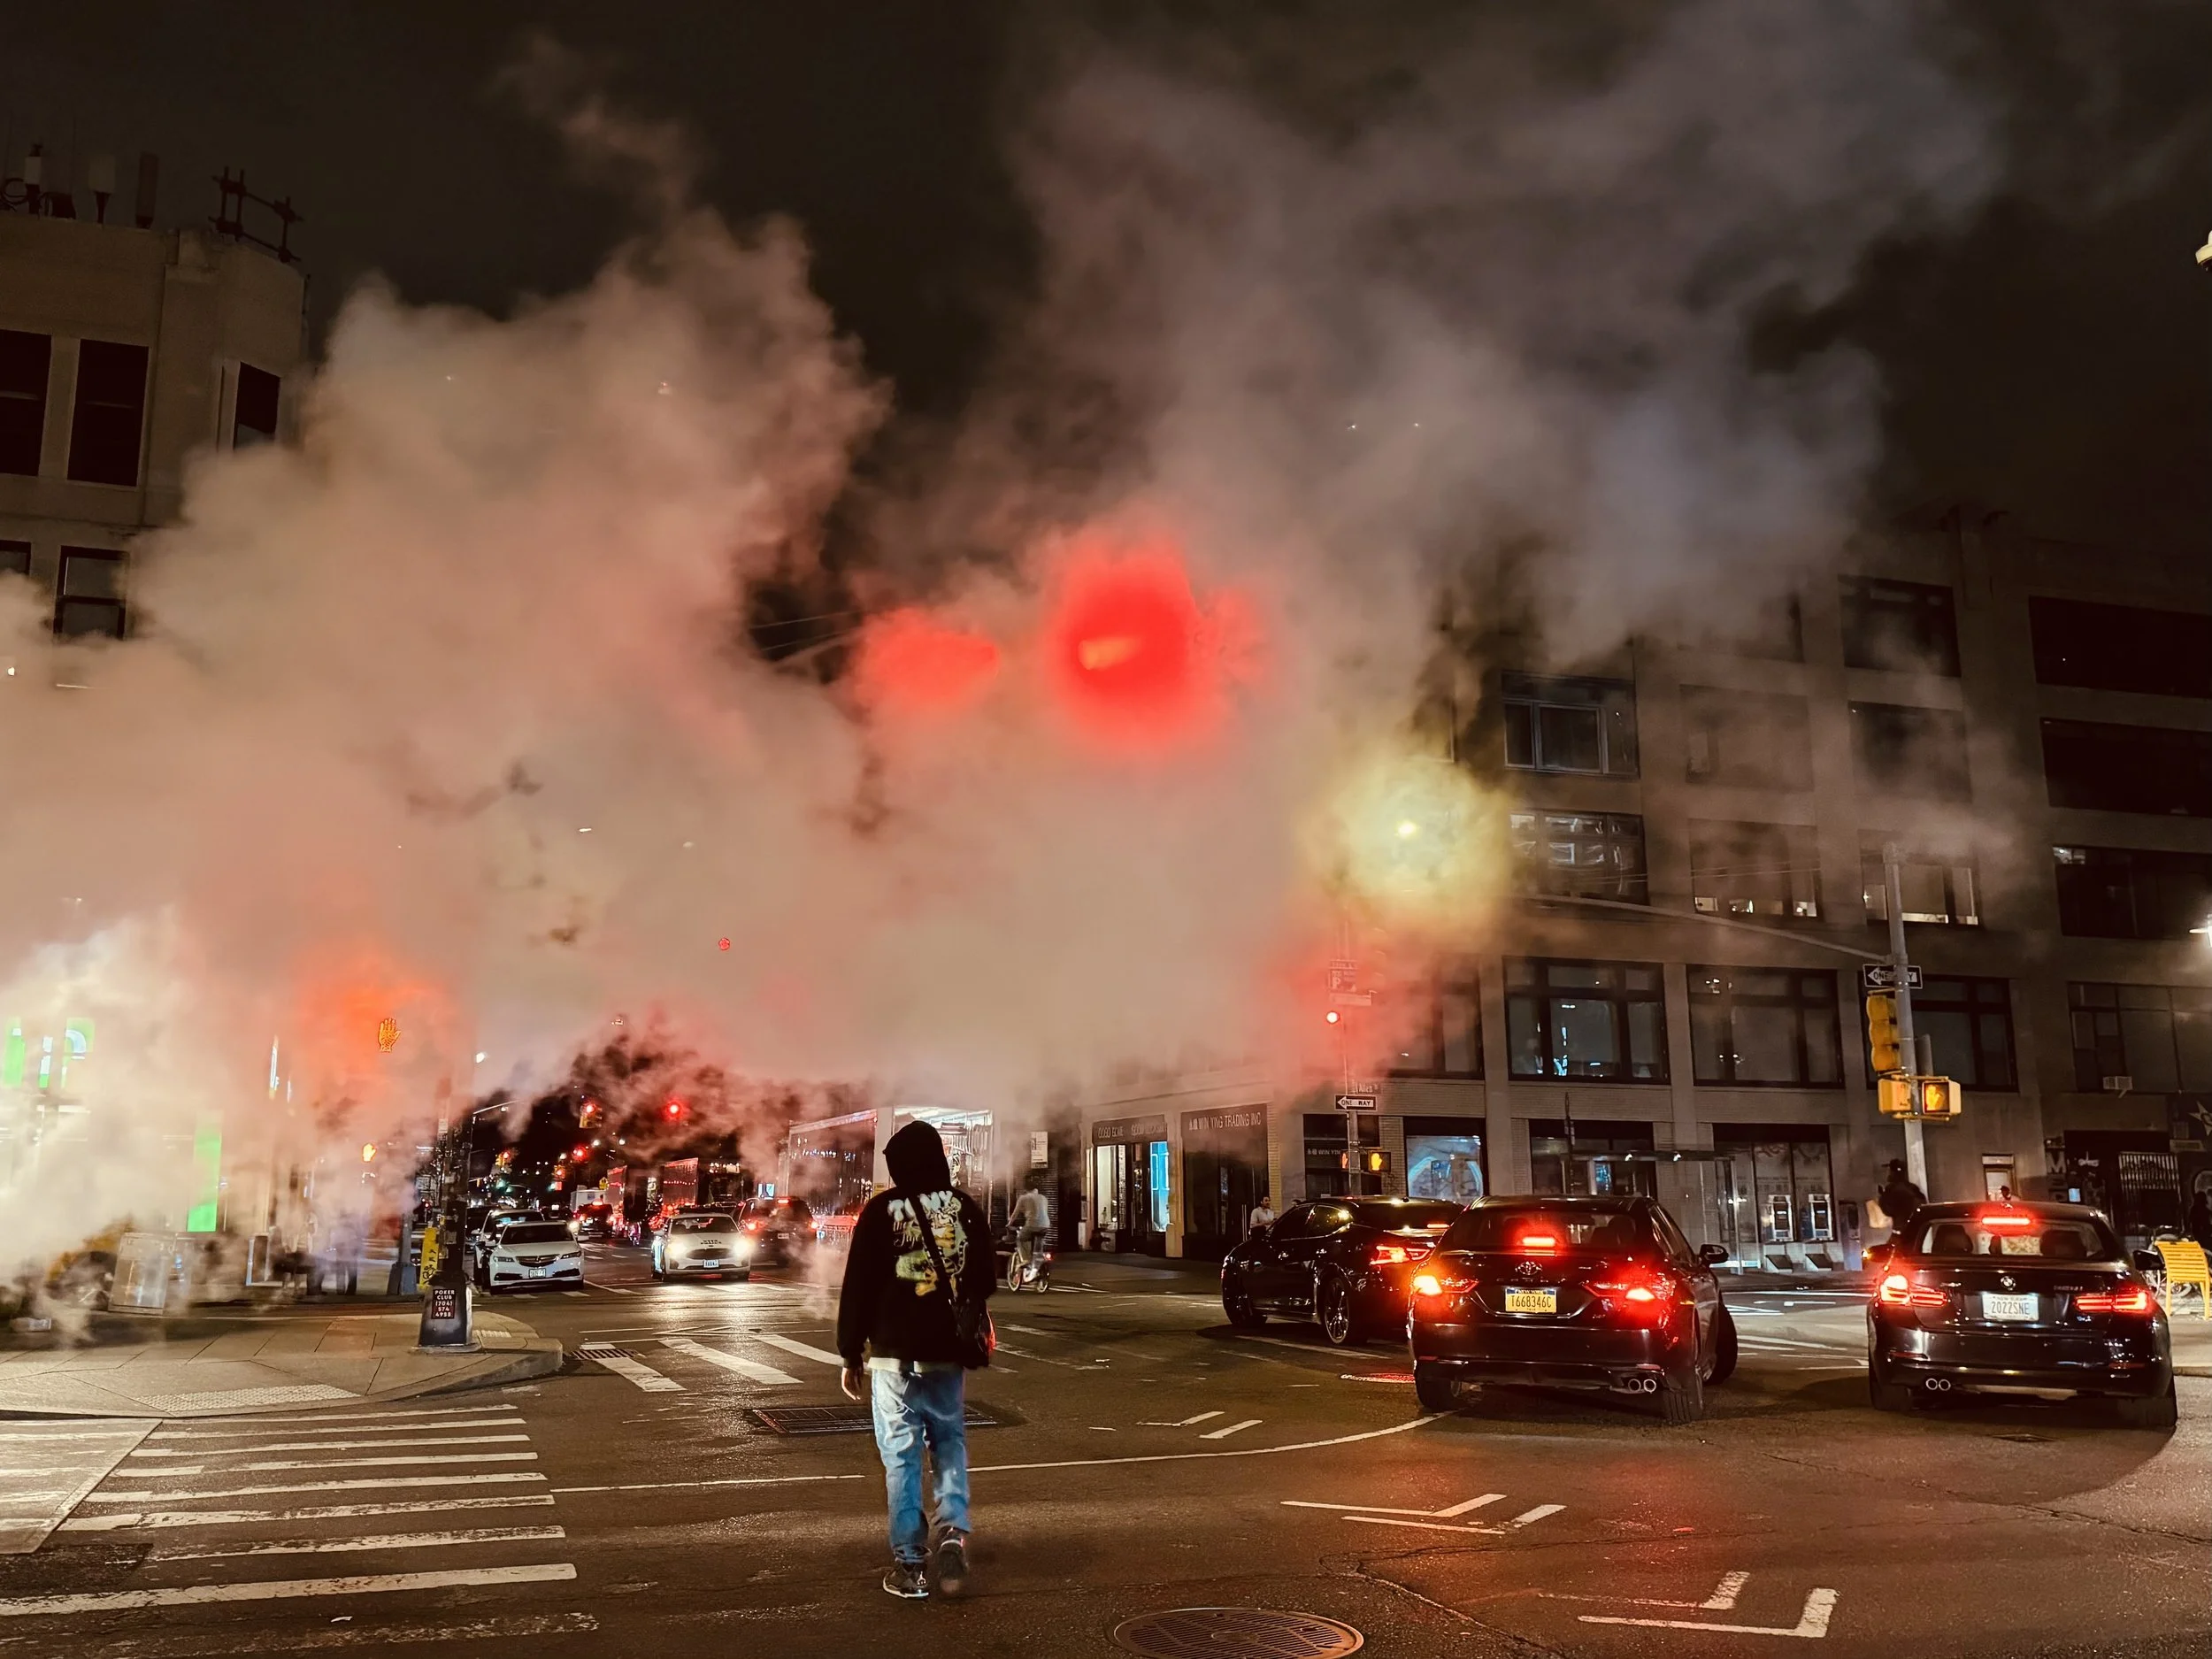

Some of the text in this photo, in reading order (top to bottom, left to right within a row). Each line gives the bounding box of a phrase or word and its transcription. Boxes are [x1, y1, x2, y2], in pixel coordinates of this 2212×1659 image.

[1873, 972, 1888, 980] ONE
[1225, 1112, 1249, 1127] TRADING
[1250, 1111, 1262, 1125] INC
[1511, 1295, 1552, 1308] T668346C
[1991, 1301, 2031, 1316] 2022SNE
